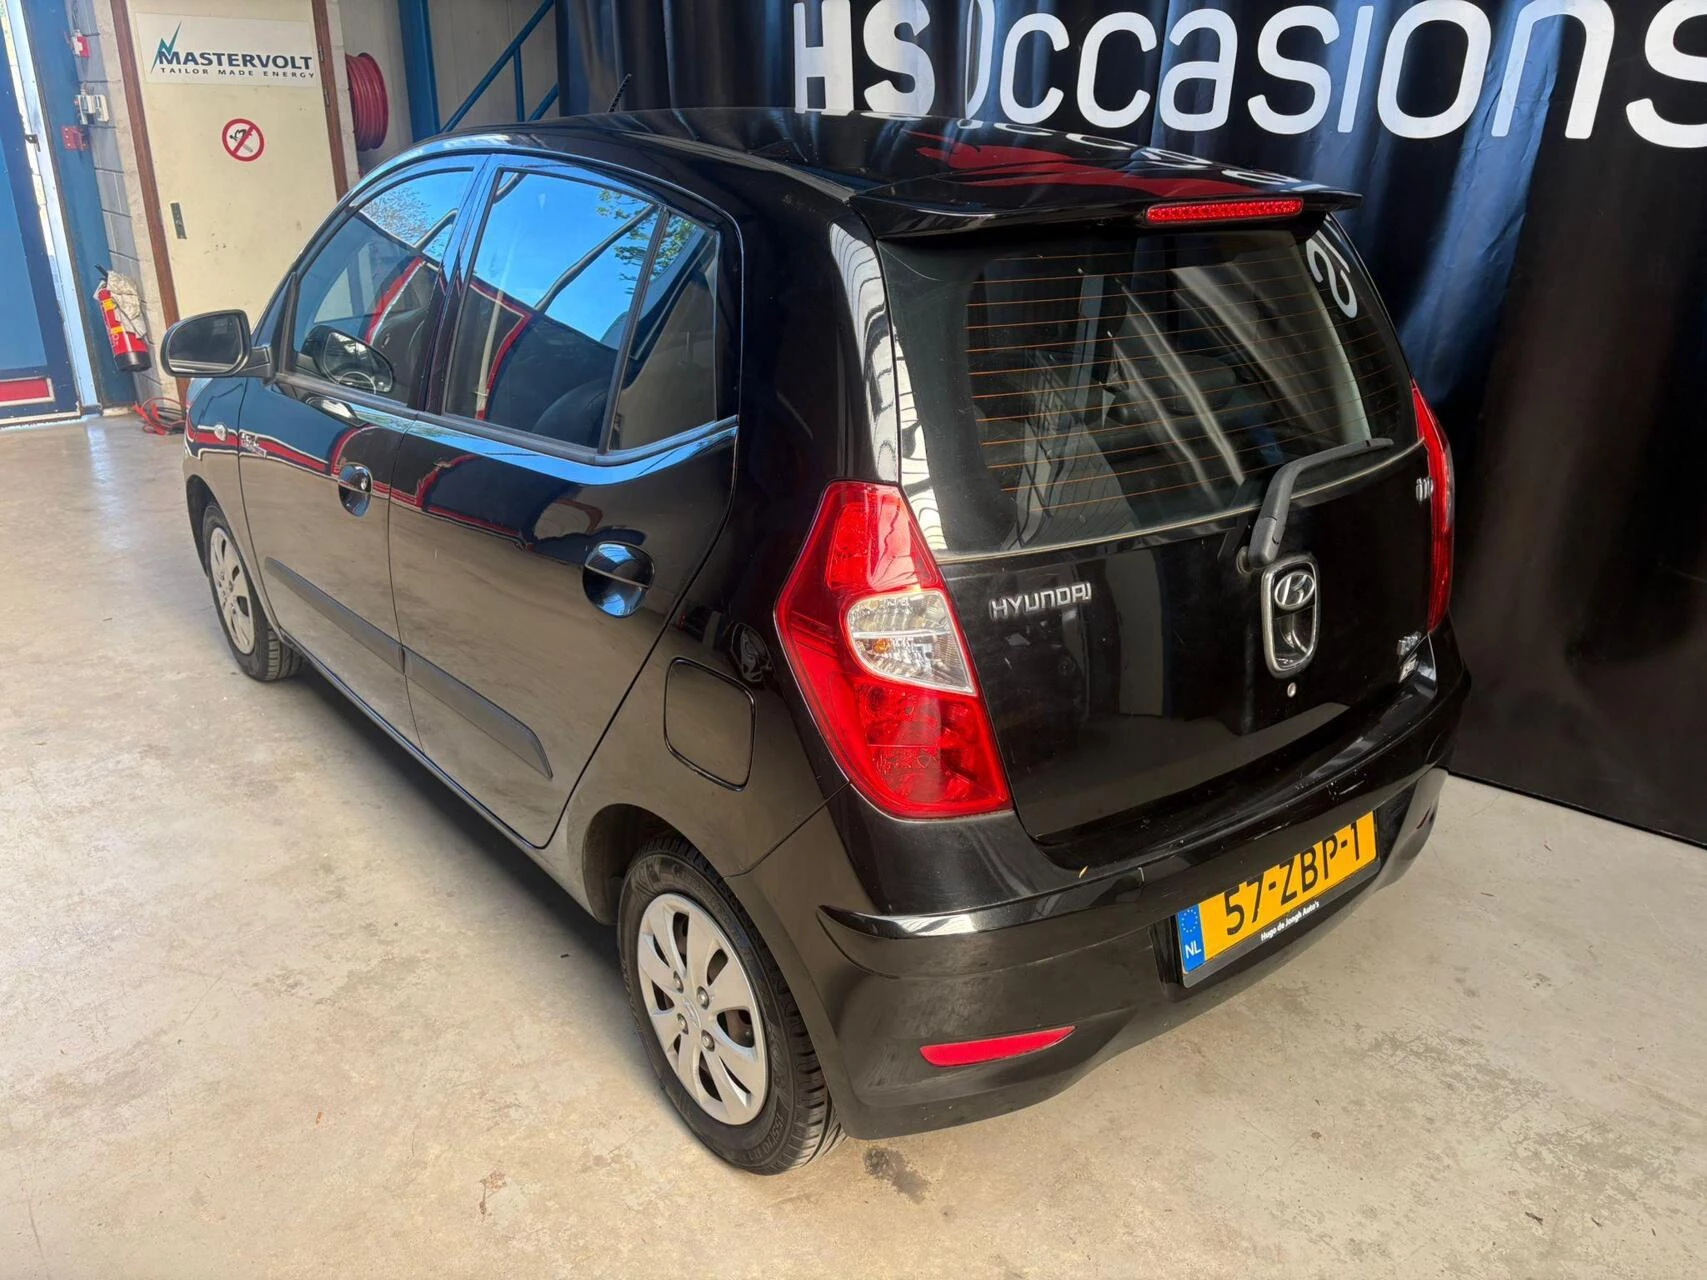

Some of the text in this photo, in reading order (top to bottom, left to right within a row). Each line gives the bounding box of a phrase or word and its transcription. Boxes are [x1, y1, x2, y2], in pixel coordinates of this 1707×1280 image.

[158, 51, 313, 70] MASTERVOLT
[793, 0, 936, 116] HS
[161, 67, 315, 79] TAILOR MADE ENERGY
[990, 582, 1092, 619] HYUNDAI
[1224, 822, 1360, 936] 57-ZBP-1
[1260, 927, 1277, 942] Hugo
[1277, 921, 1285, 932] de
[1184, 940, 1202, 960] NL
